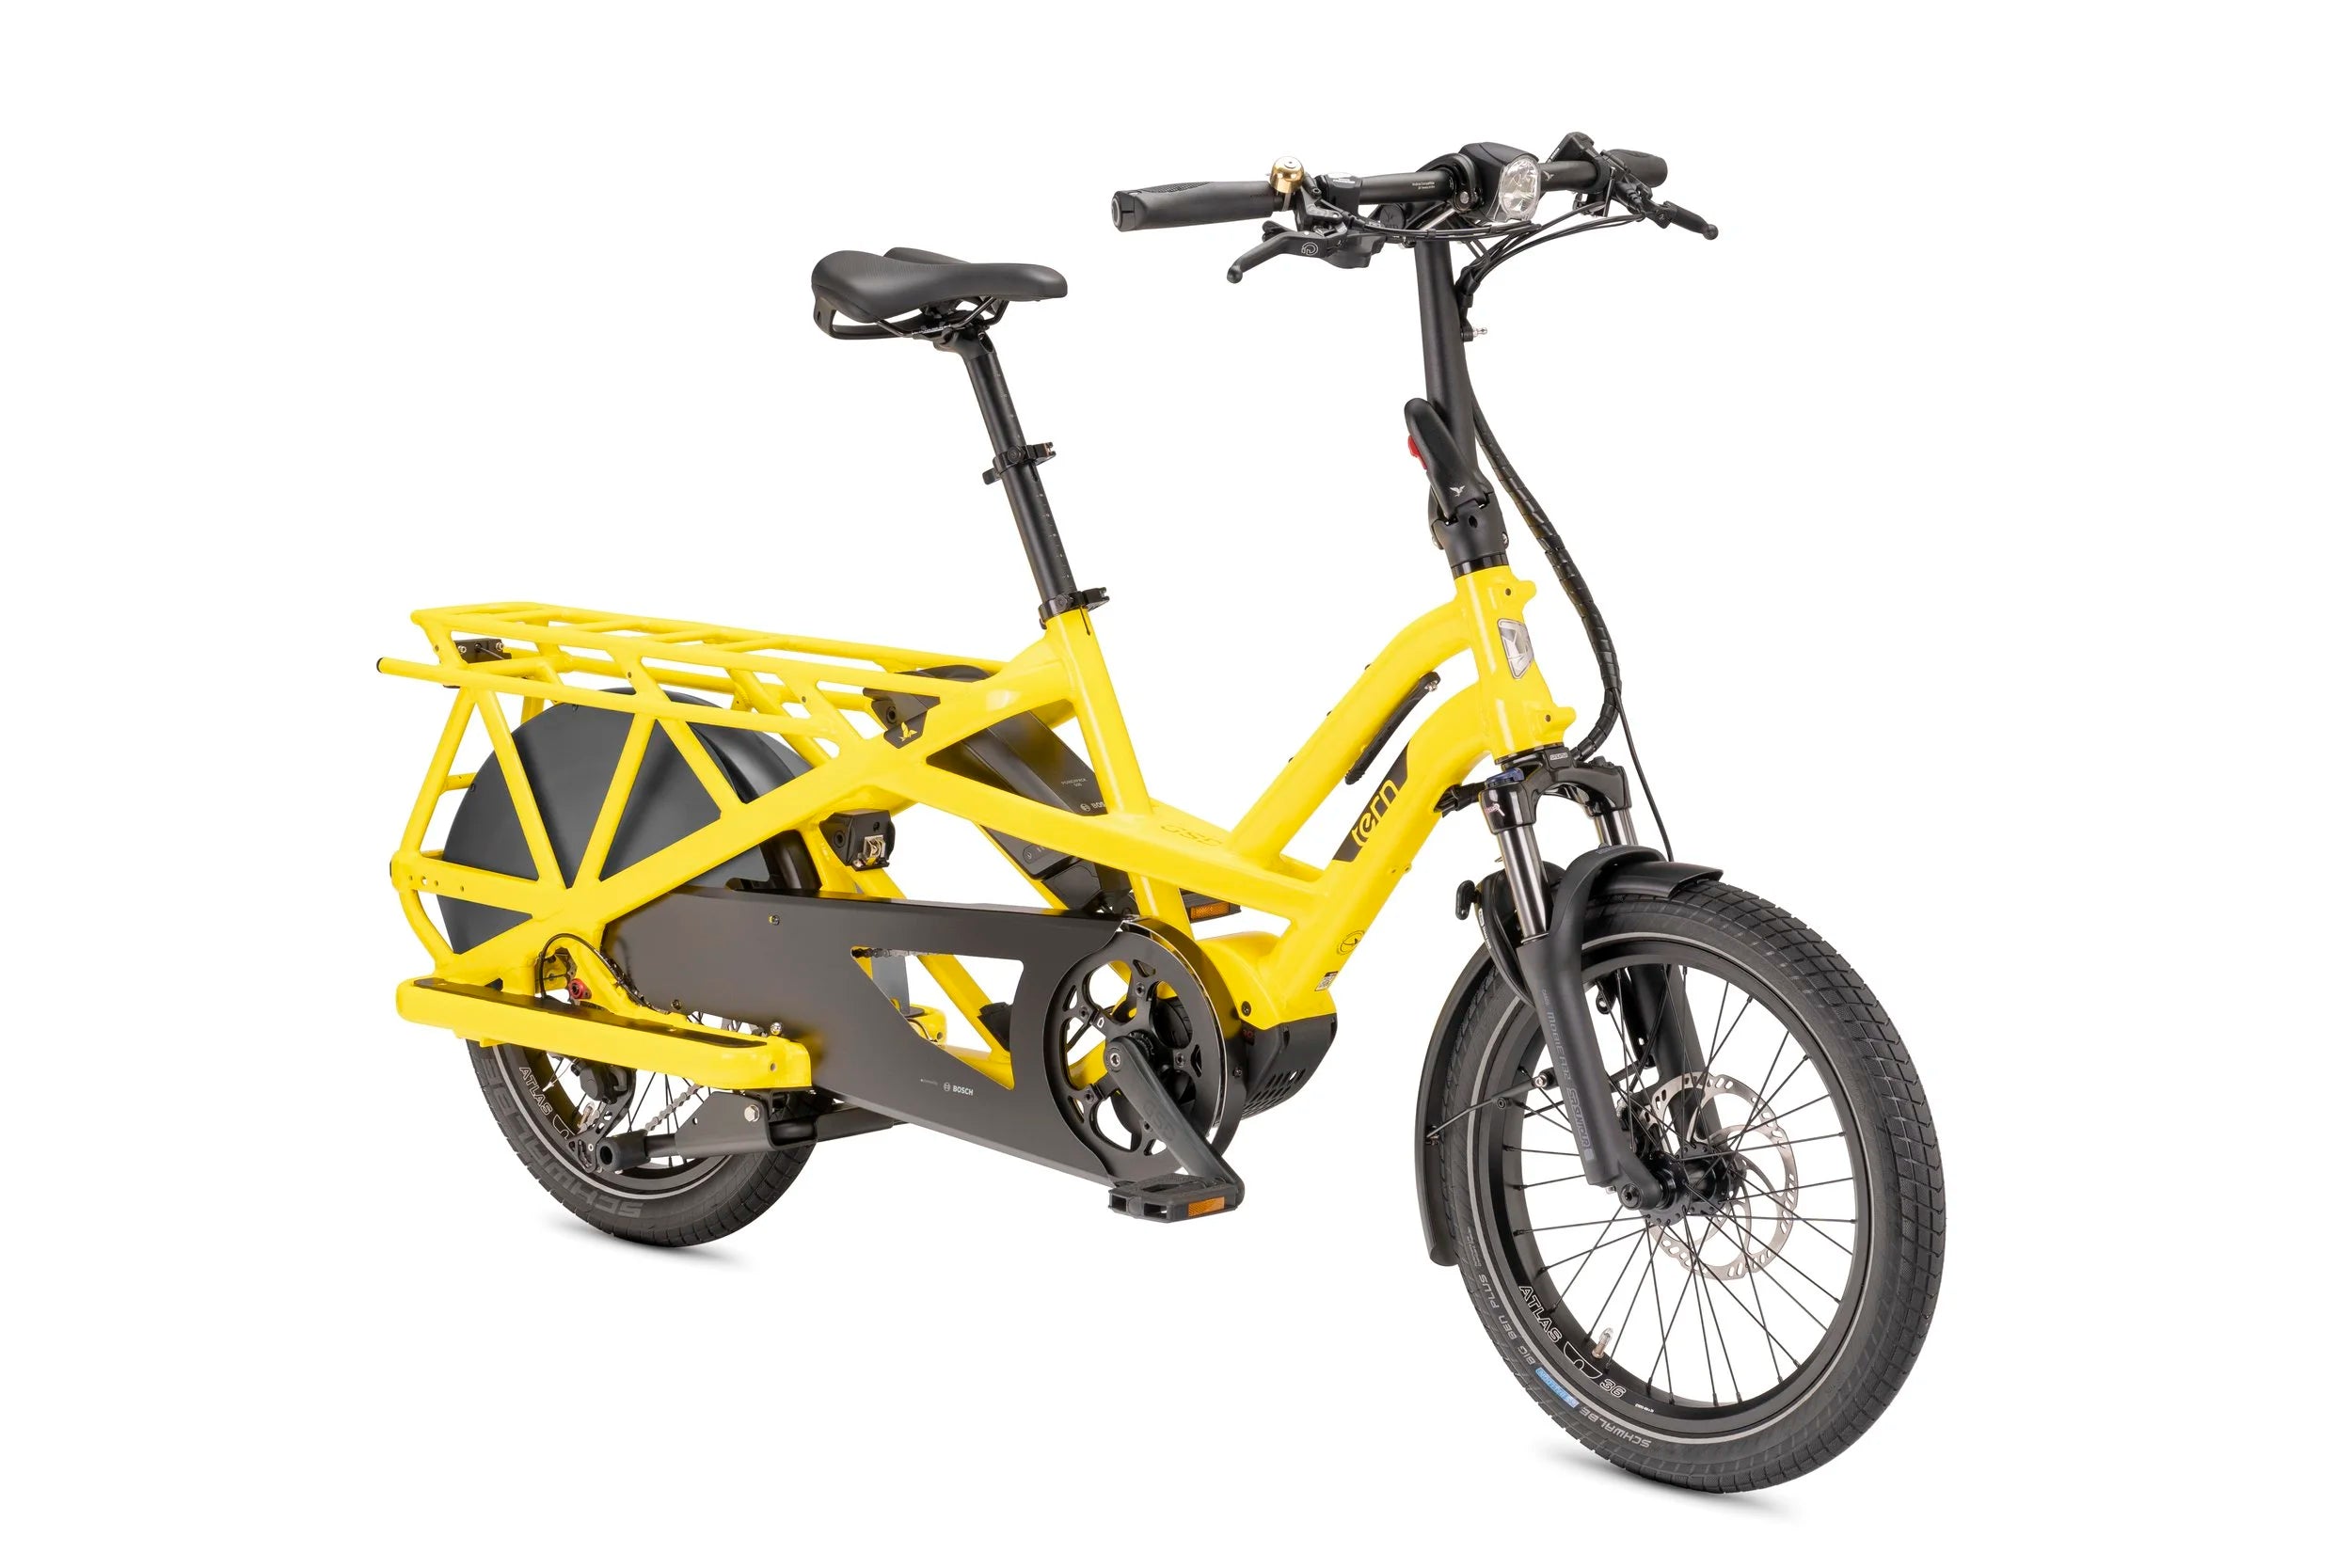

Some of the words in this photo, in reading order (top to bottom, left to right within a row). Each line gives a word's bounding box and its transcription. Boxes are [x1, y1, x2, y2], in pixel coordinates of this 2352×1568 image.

[1351, 779, 1399, 847] tern
[518, 1067, 553, 1116] ATLAS
[952, 1085, 974, 1097] BOSCH
[1478, 1274, 1501, 1308] PLUS
[1517, 1345, 1536, 1366] BIG
[1518, 1285, 1563, 1343] ATLAS
[1599, 1378, 1627, 1399] 36
[1579, 1406, 1652, 1449] SCHWALBE
